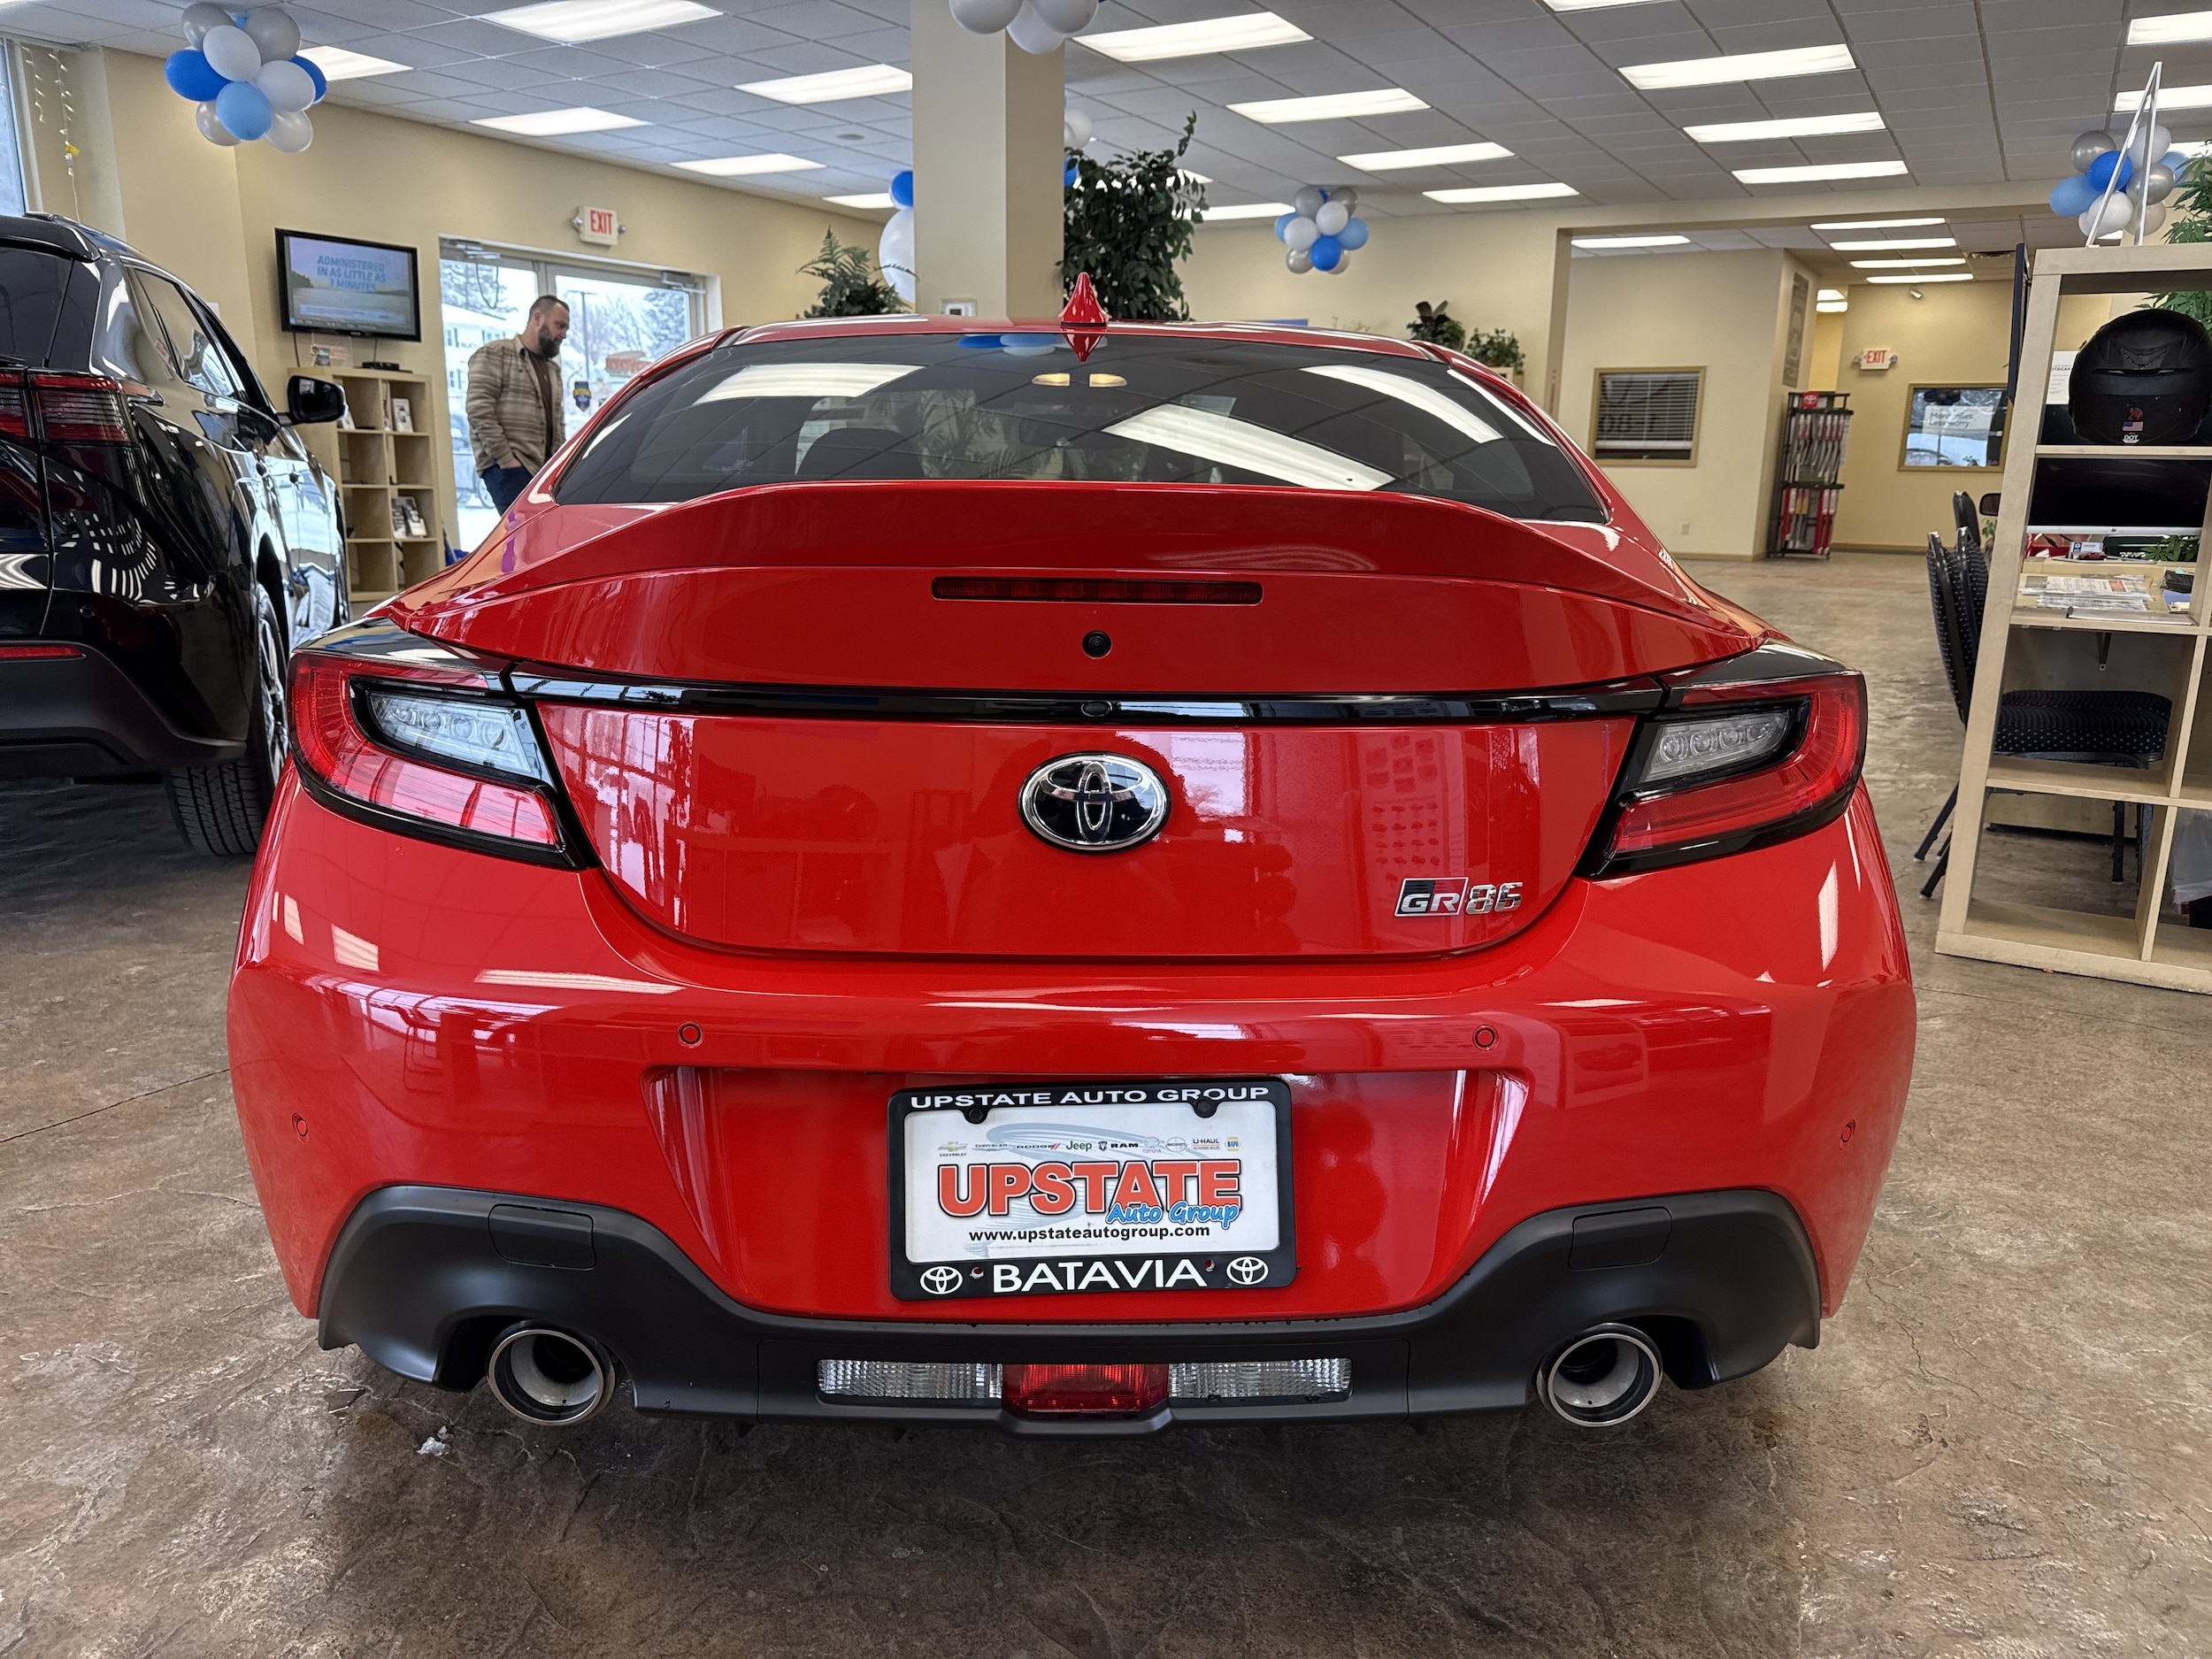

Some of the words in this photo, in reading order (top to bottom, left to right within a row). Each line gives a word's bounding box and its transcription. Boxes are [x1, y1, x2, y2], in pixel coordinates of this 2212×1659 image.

[590, 210, 612, 235] EXIT
[317, 255, 385, 273] ADMINISTERED
[318, 265, 328, 276] IN
[330, 267, 342, 278] AS
[344, 269, 373, 281] LITTLE
[375, 273, 386, 283] AS
[329, 278, 334, 288] 3
[337, 279, 377, 291] MINUTES
[1866, 350, 1886, 364] EXIT
[910, 1092, 1052, 1109] UPSTATE
[1060, 1089, 1148, 1104] AUTO
[1156, 1087, 1270, 1102] GROUP
[1065, 1141, 1093, 1151] Jeep
[937, 1159, 1242, 1217] UPSTATE
[1106, 1202, 1163, 1224] Auto
[1169, 1200, 1240, 1230] Group
[969, 1225, 1210, 1241] www.upstateautogroup.com
[993, 1259, 1208, 1293] BATAVIA
